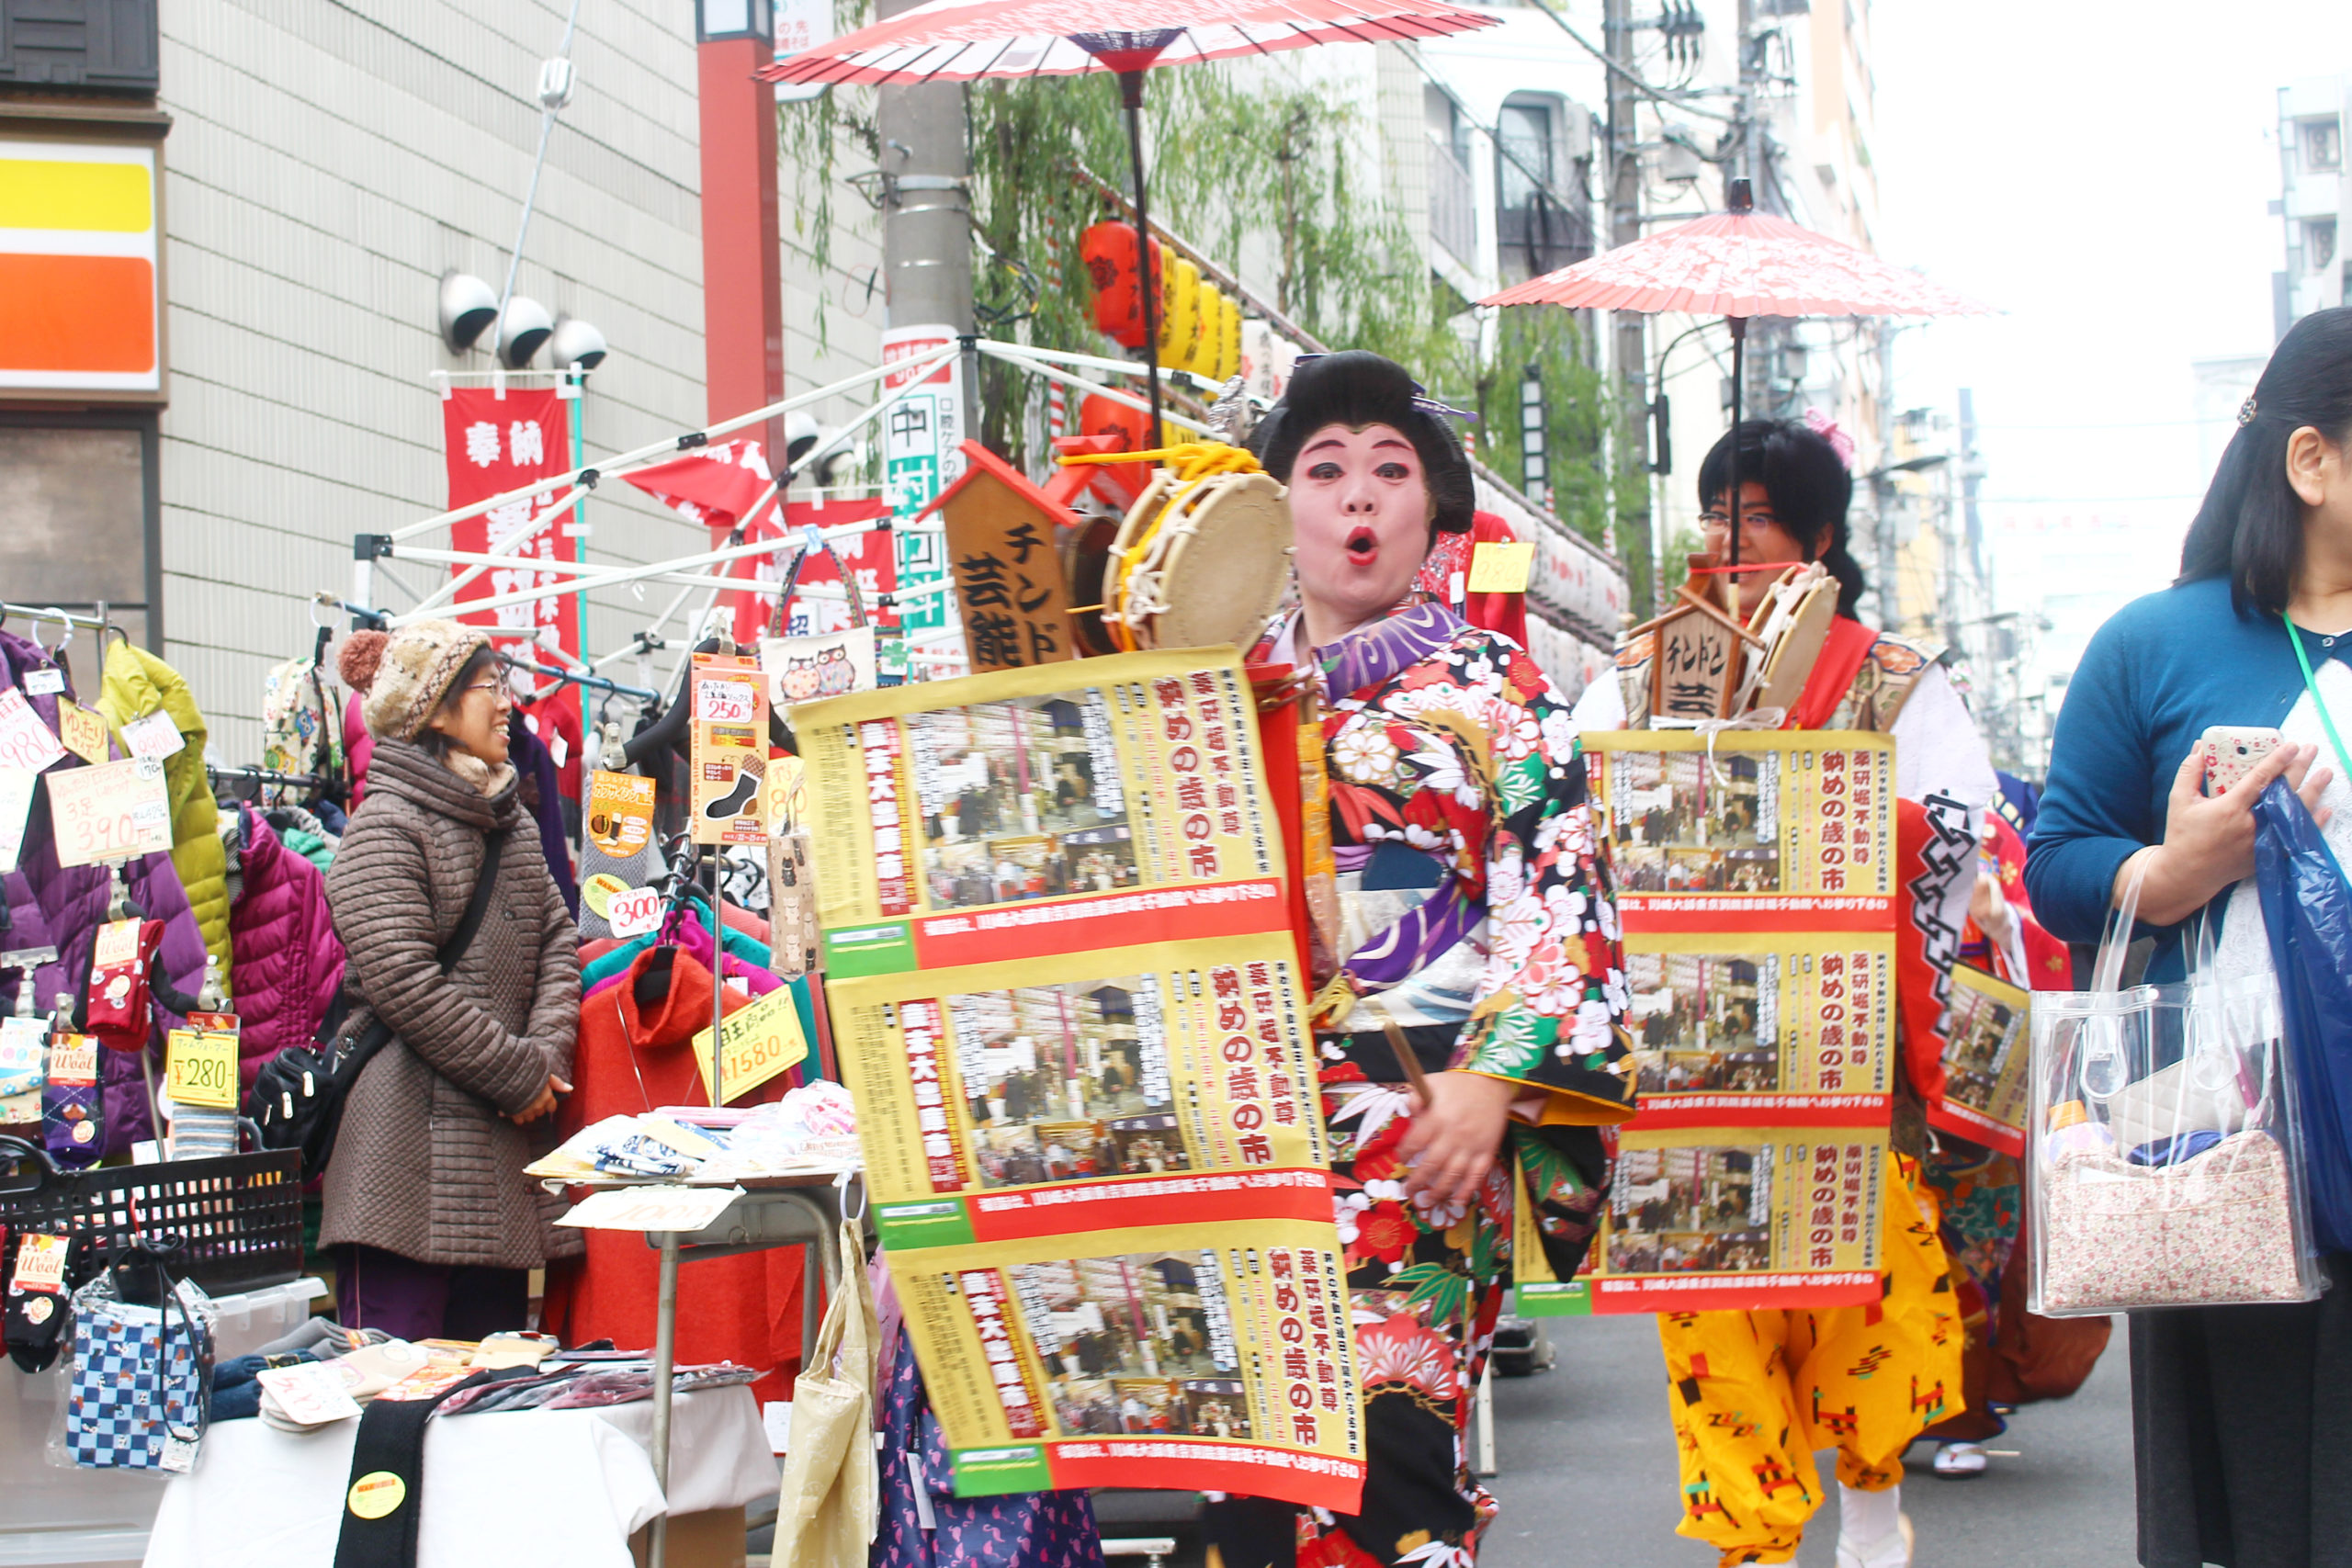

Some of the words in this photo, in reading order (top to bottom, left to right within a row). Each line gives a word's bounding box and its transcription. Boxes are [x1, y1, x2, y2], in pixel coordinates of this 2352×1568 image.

[466, 421, 544, 468] 奉納
[708, 700, 741, 719] 250
[1152, 676, 1220, 879] 納めの歳の市
[1852, 750, 1871, 864] 薬研堀不動尊
[76, 814, 133, 852] 390
[1820, 750, 1846, 891] 納めの歳の市
[99, 937, 135, 957] Wool
[614, 896, 658, 928] 300
[52, 1053, 95, 1071] Wool
[1818, 953, 1845, 1091] 納めの歳の市
[1211, 964, 1275, 1165] 納めの歳の市
[1809, 1145, 1838, 1269] 納めの歳の市
[20, 1254, 62, 1275] Wool
[1267, 1246, 1318, 1447] 納めの歳の市
